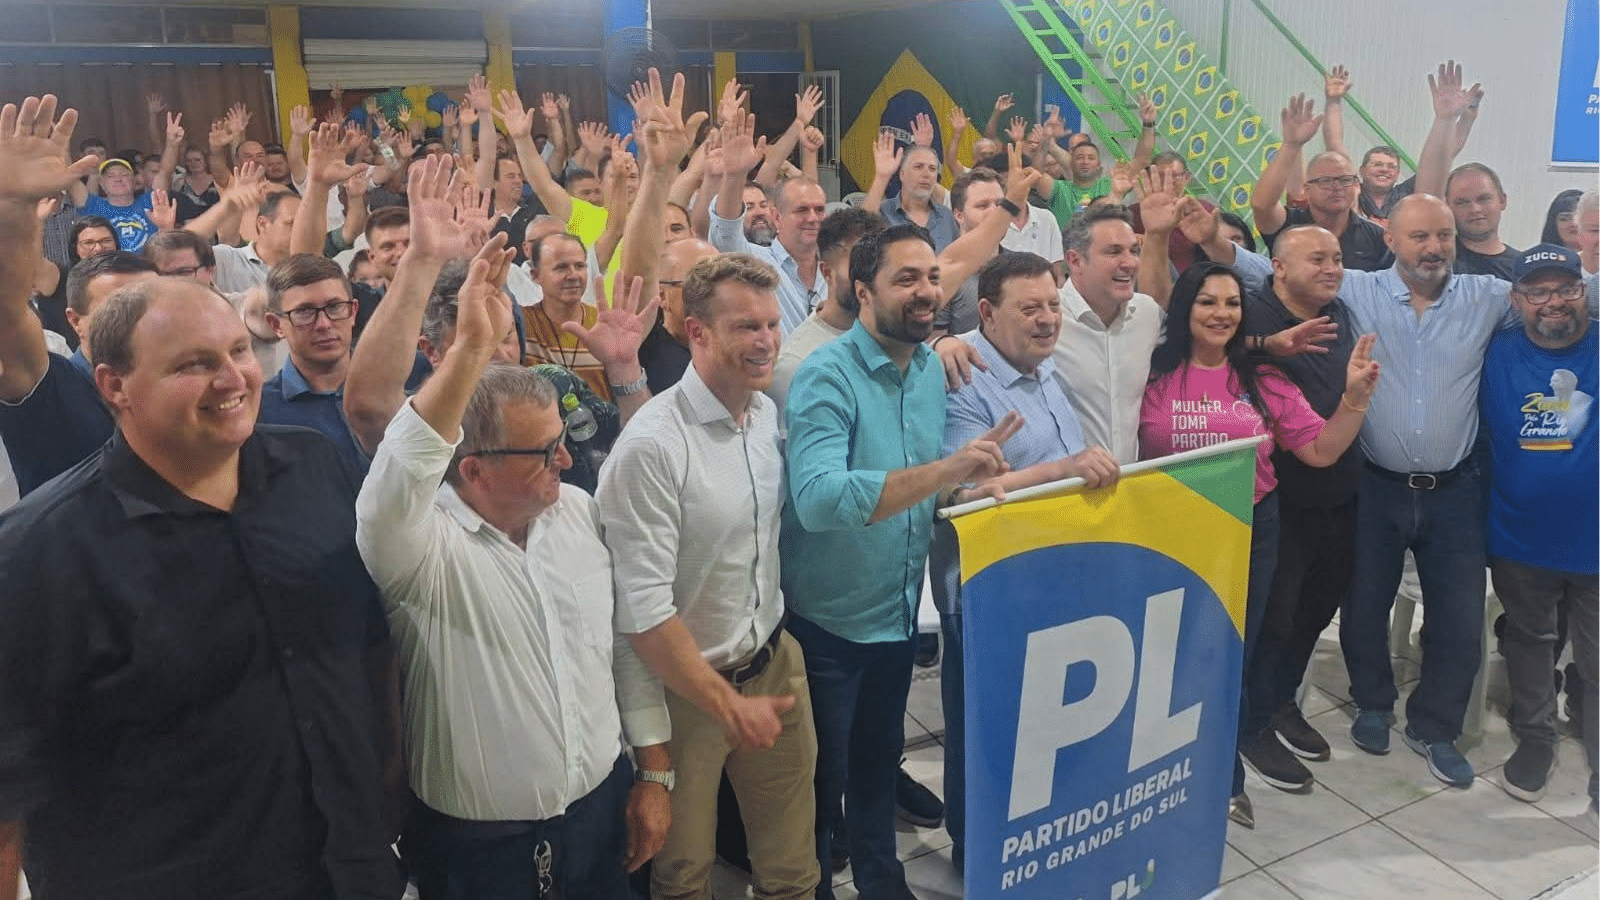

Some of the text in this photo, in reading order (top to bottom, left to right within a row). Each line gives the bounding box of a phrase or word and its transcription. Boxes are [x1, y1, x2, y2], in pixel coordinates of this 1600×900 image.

[1172, 415, 1208, 430] TOMA
[1008, 587, 1203, 822] PL
[1001, 787, 1189, 891] RIO GRANDE DO SUL
[1002, 757, 1192, 864] PARTIDO LIBERAL
